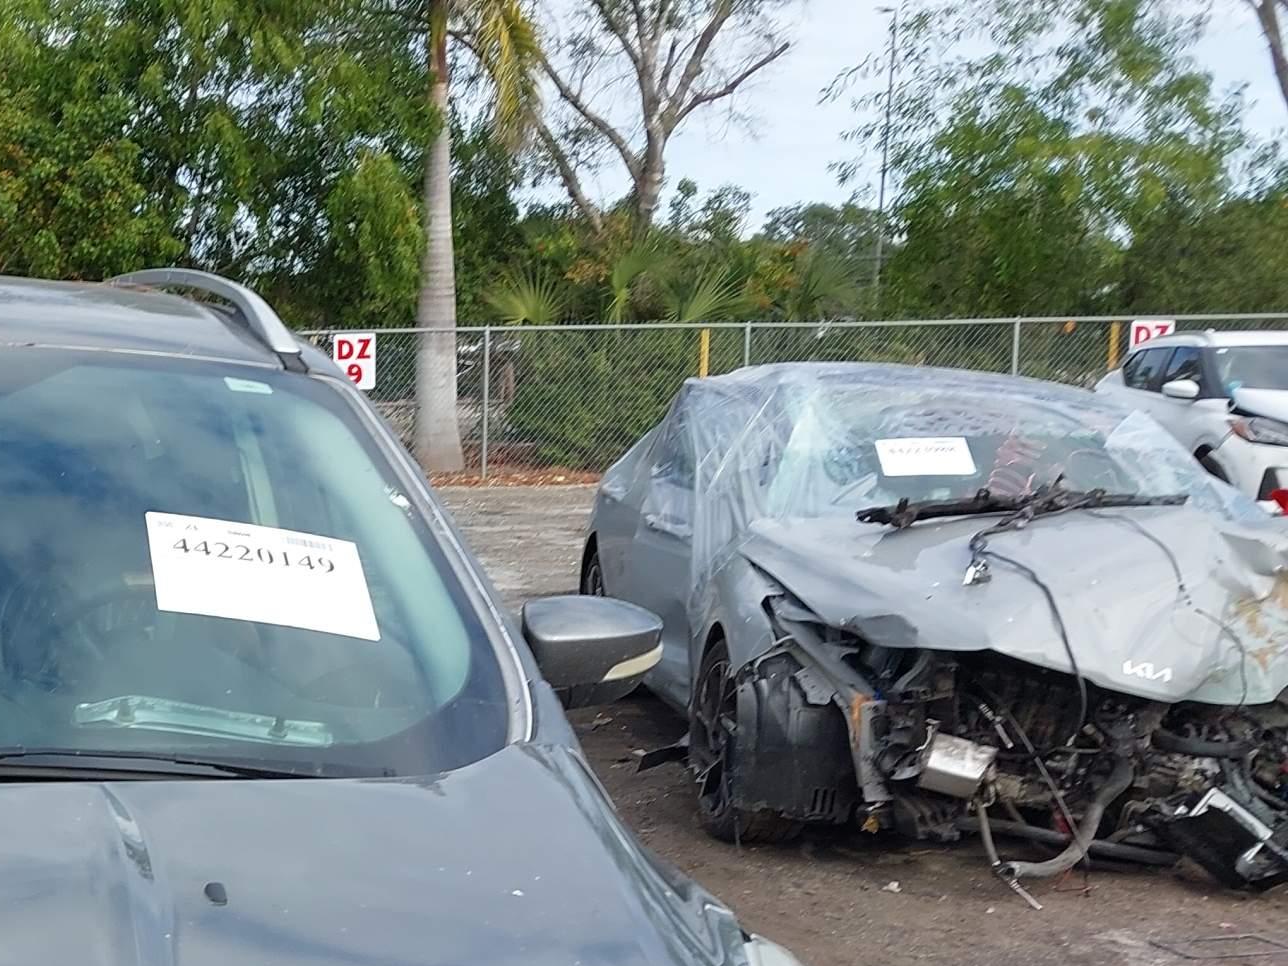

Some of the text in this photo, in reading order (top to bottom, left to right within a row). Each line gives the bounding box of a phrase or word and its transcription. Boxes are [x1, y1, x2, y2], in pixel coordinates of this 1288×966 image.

[338, 338, 371, 360] DZ
[347, 364, 362, 385] 9
[173, 538, 335, 573] 44220149
